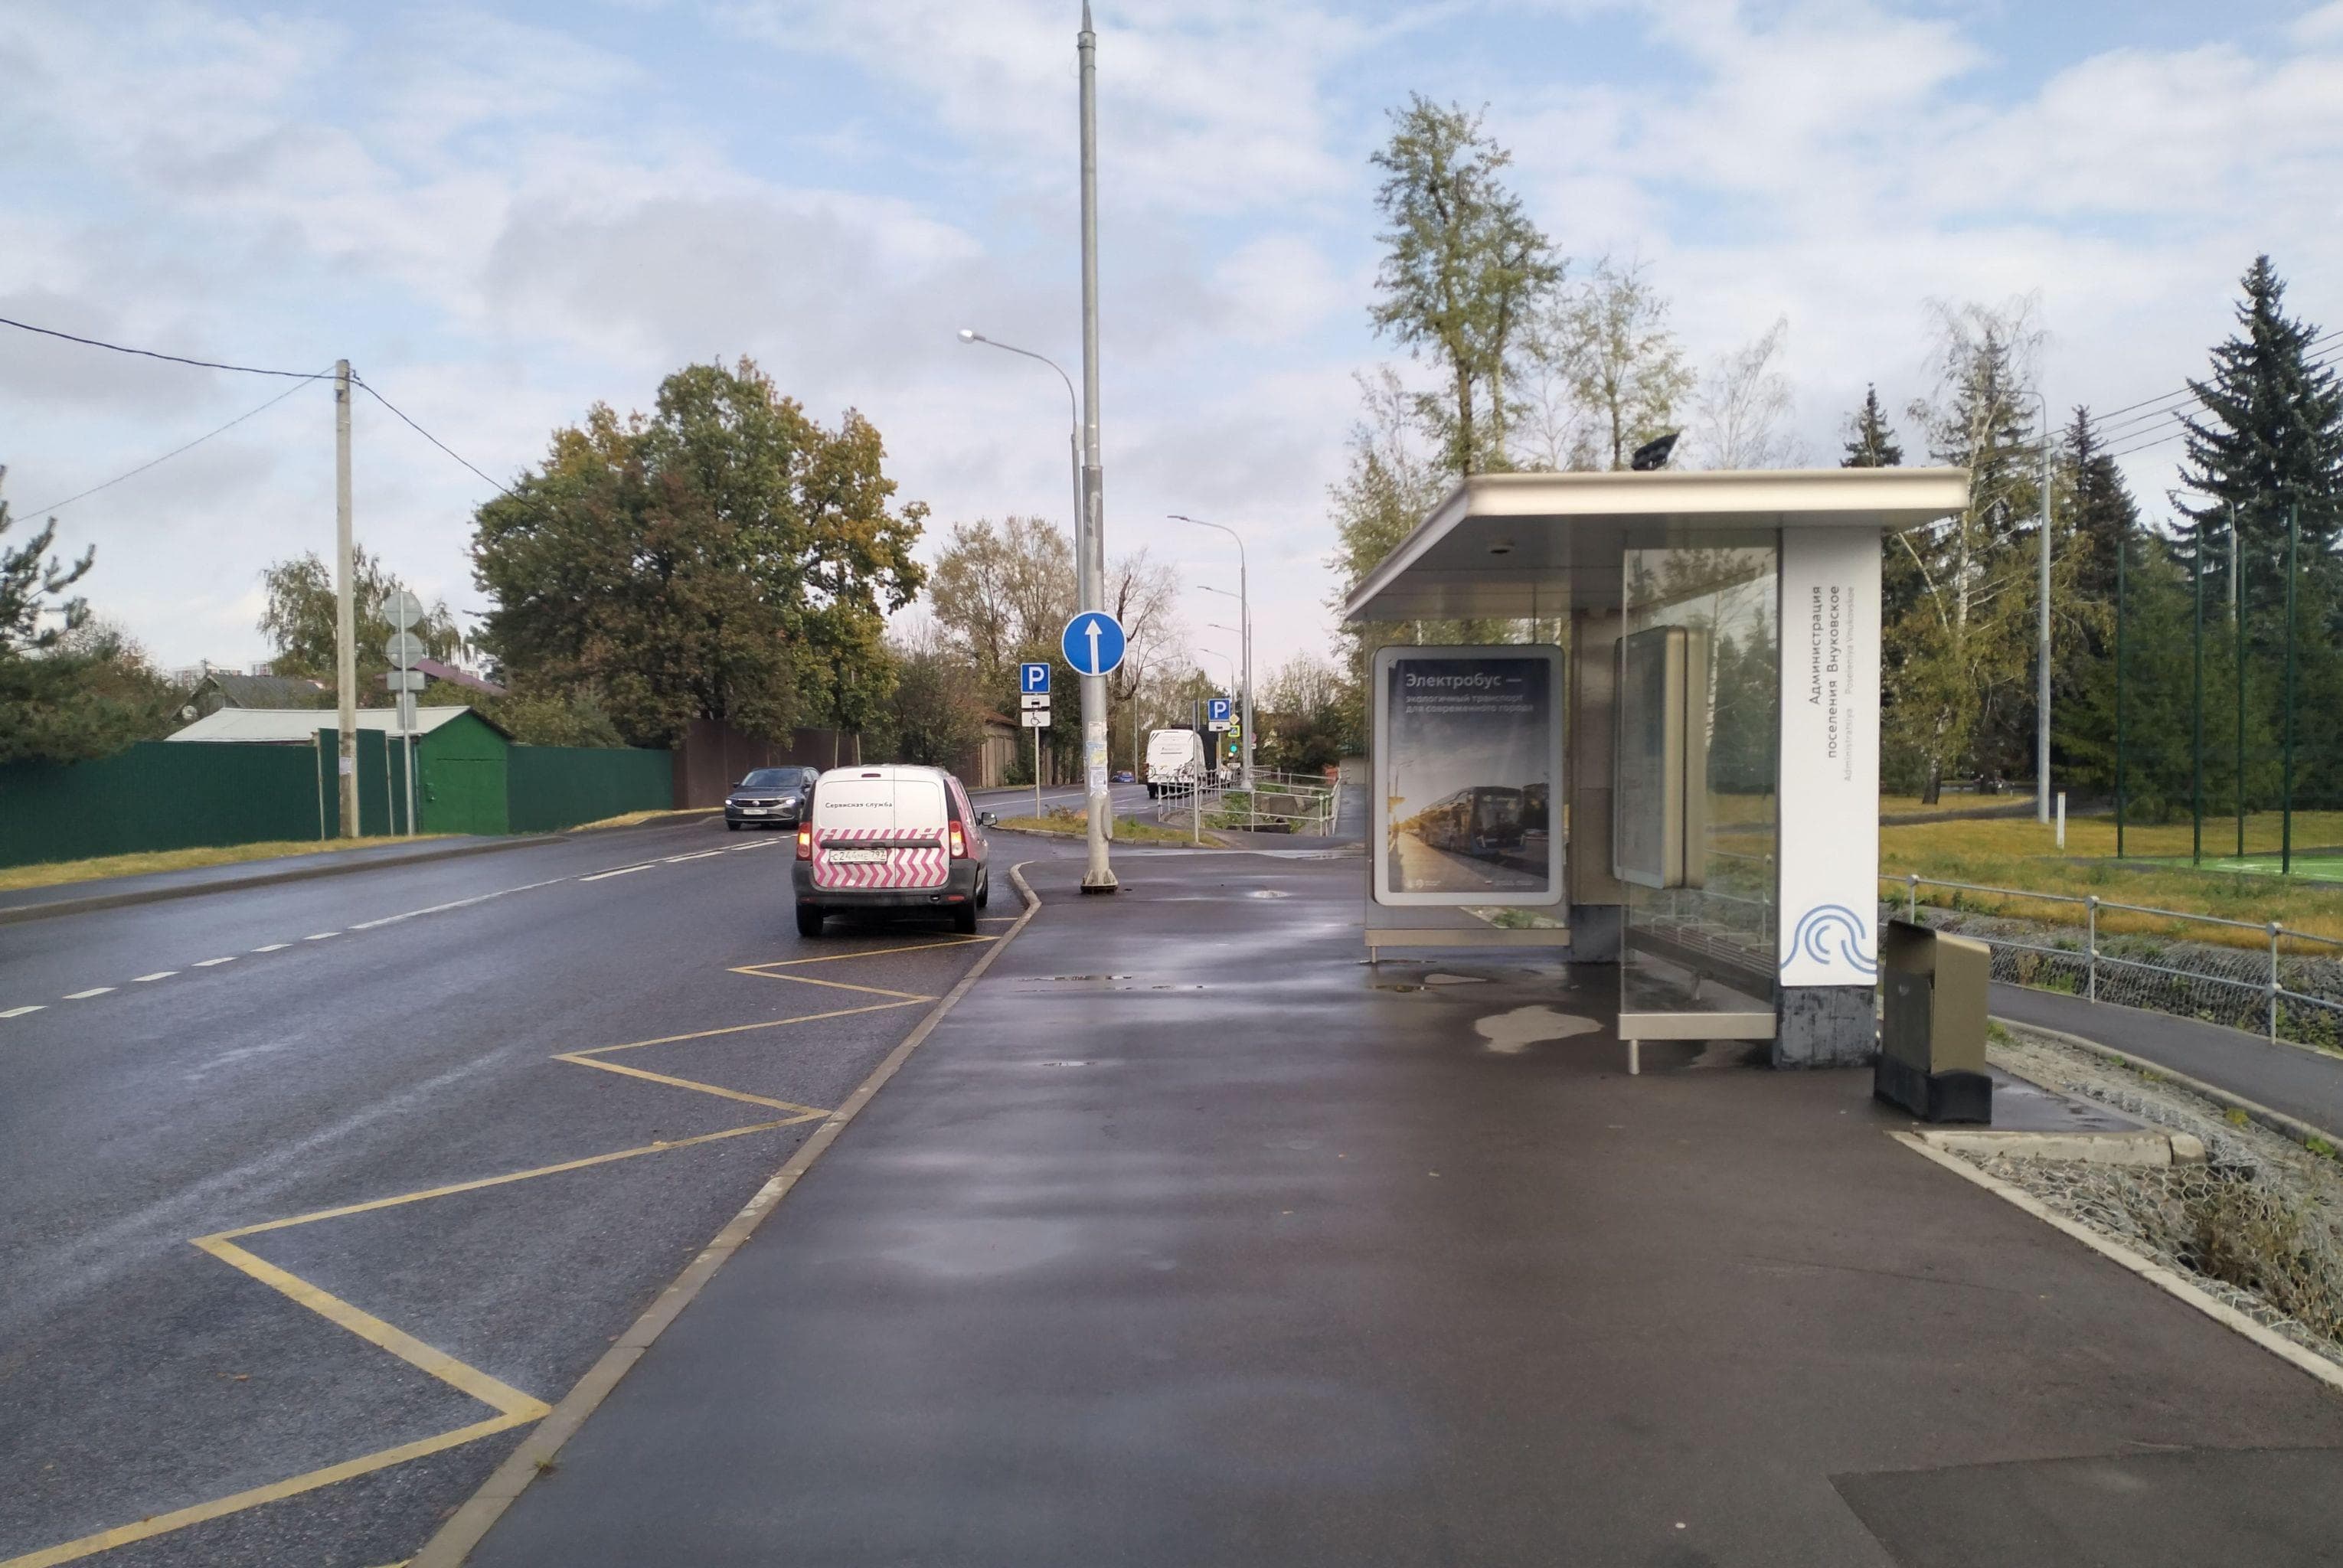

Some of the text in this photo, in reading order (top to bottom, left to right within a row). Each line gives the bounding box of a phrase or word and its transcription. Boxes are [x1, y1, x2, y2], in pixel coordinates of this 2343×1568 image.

[1809, 586, 1824, 705] Администрация
[1028, 666, 1045, 691] P
[1406, 672, 1502, 690] Электробус
[1827, 586, 1841, 759] поселения Внуковское
[1214, 701, 1227, 719] P
